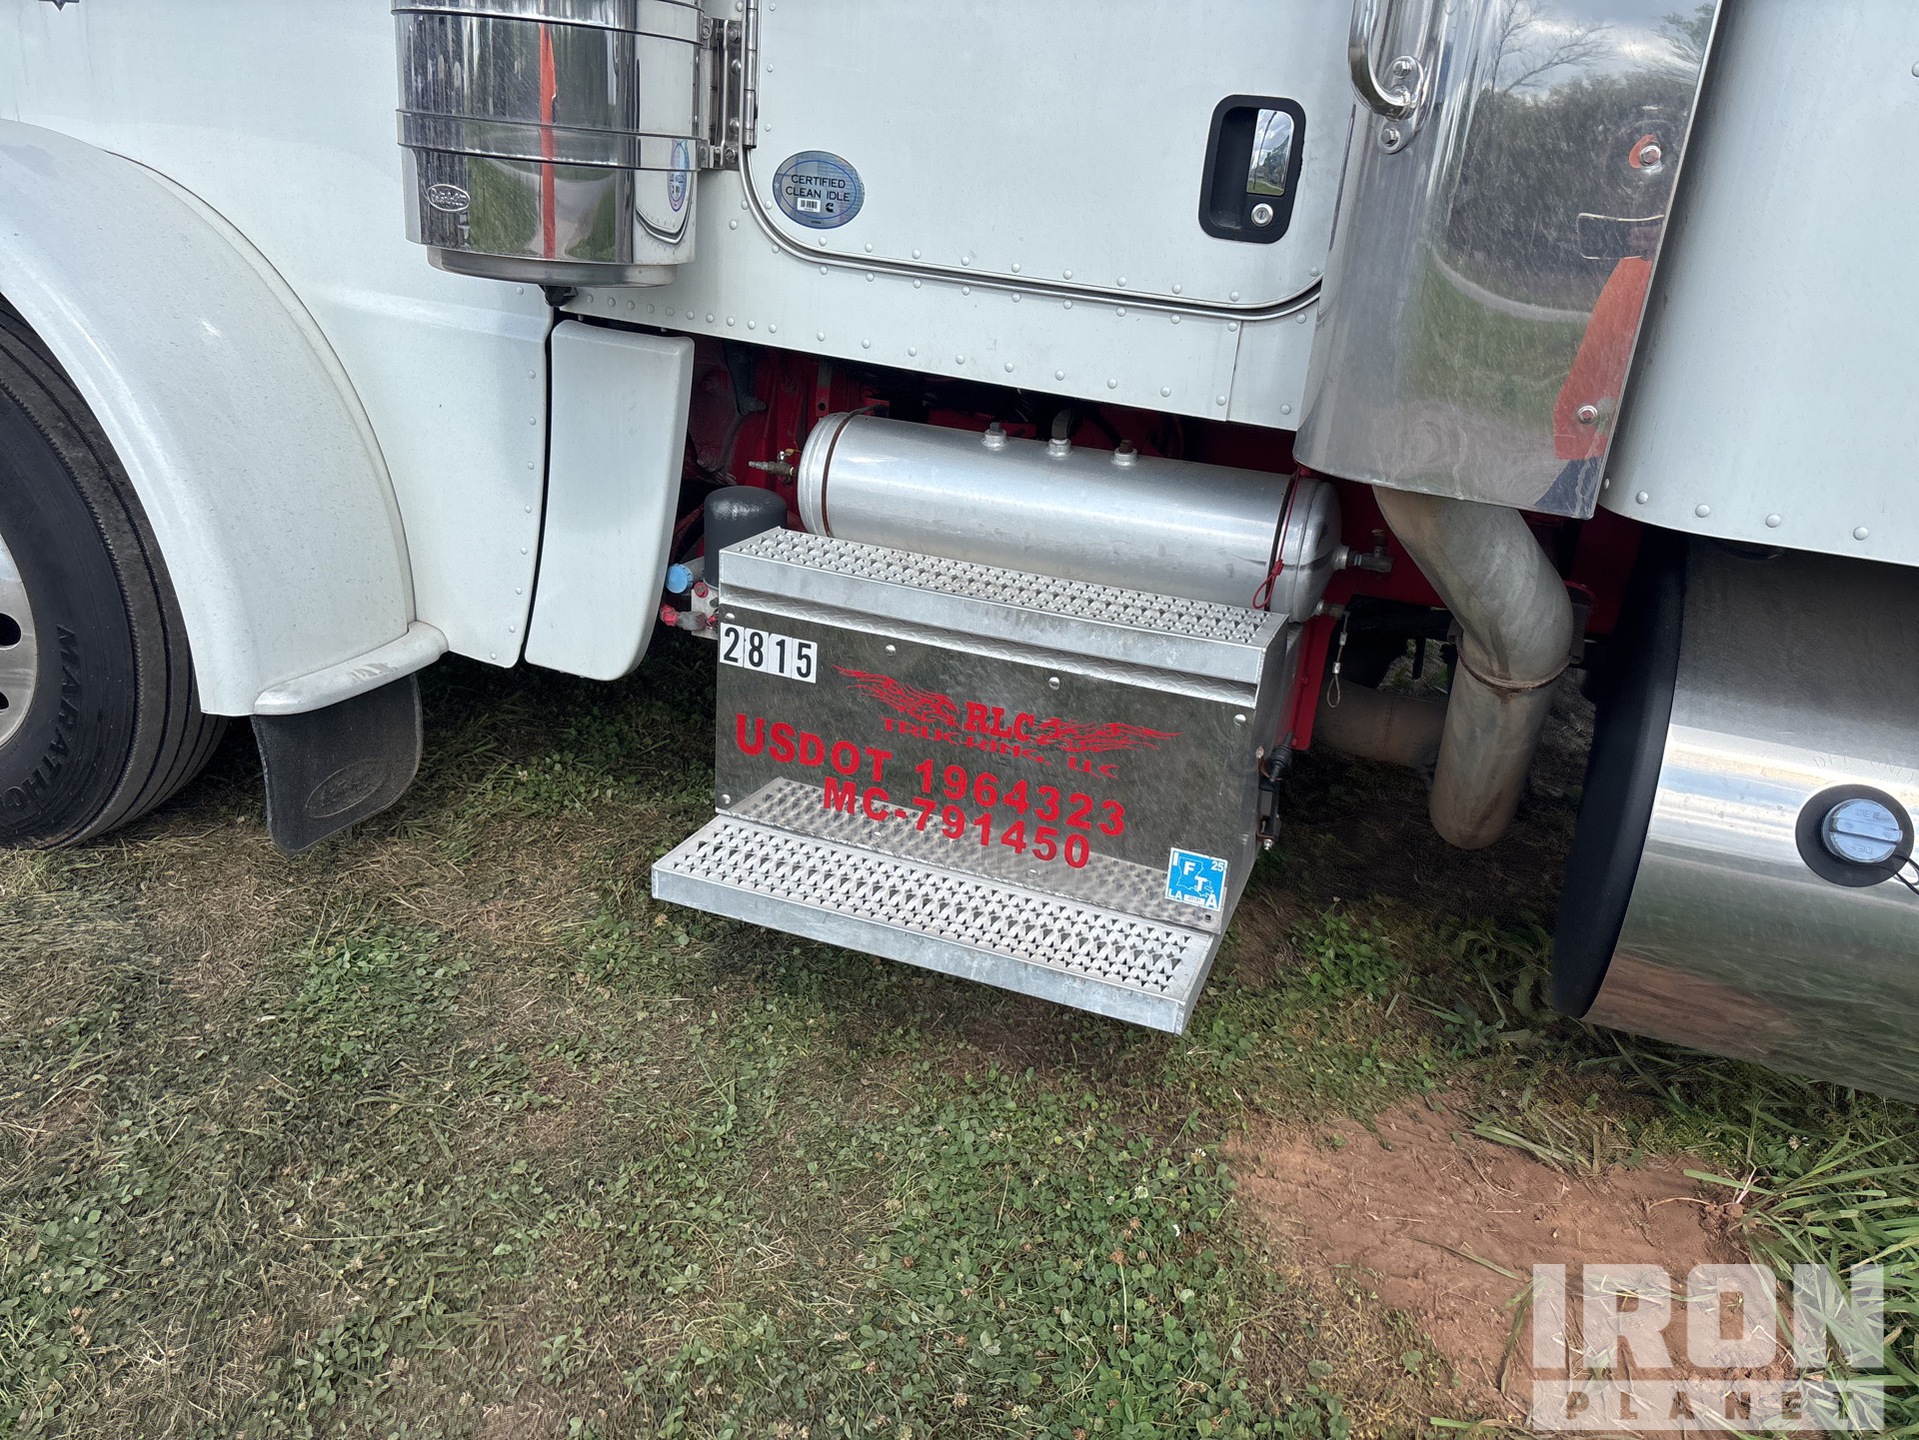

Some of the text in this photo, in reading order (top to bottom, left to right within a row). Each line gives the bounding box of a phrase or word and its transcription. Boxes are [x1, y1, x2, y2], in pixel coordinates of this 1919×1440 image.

[785, 186, 851, 202] CLEAN IDLE
[791, 174, 846, 188] CERTIFIED
[723, 627, 812, 678] 2815
[964, 701, 1036, 741] RLC
[735, 713, 1126, 837] USDOT 1964323
[1067, 755, 1120, 781] LLC
[823, 776, 1091, 869] MC-791450
[1210, 860, 1224, 872] 25
[1168, 888, 1183, 900] LA
